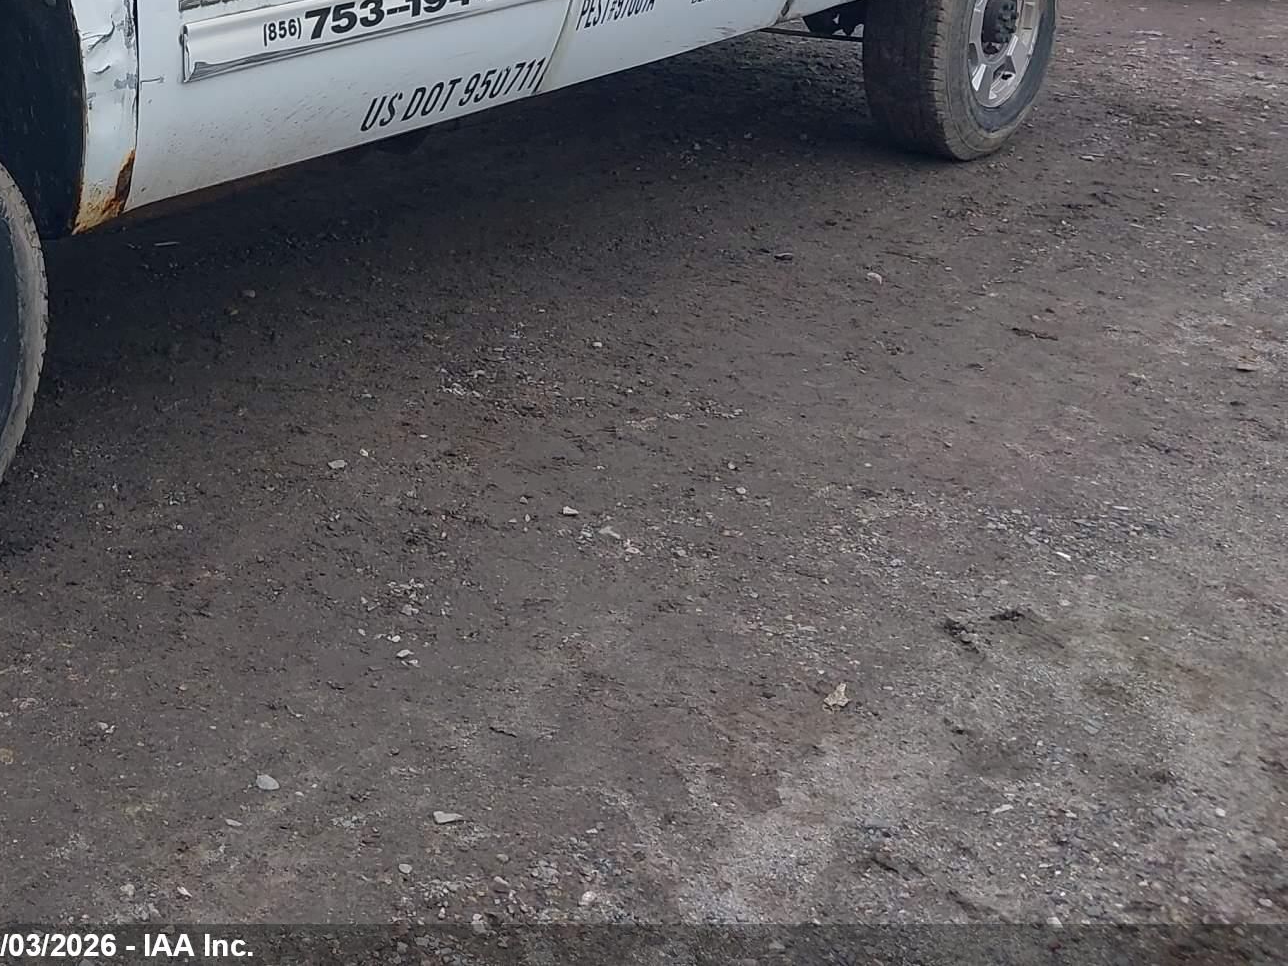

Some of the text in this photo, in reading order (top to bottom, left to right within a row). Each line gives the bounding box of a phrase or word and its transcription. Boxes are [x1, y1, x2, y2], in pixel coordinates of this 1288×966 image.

[263, 17, 302, 46] (856)
[360, 57, 546, 132] US DOT 950711
